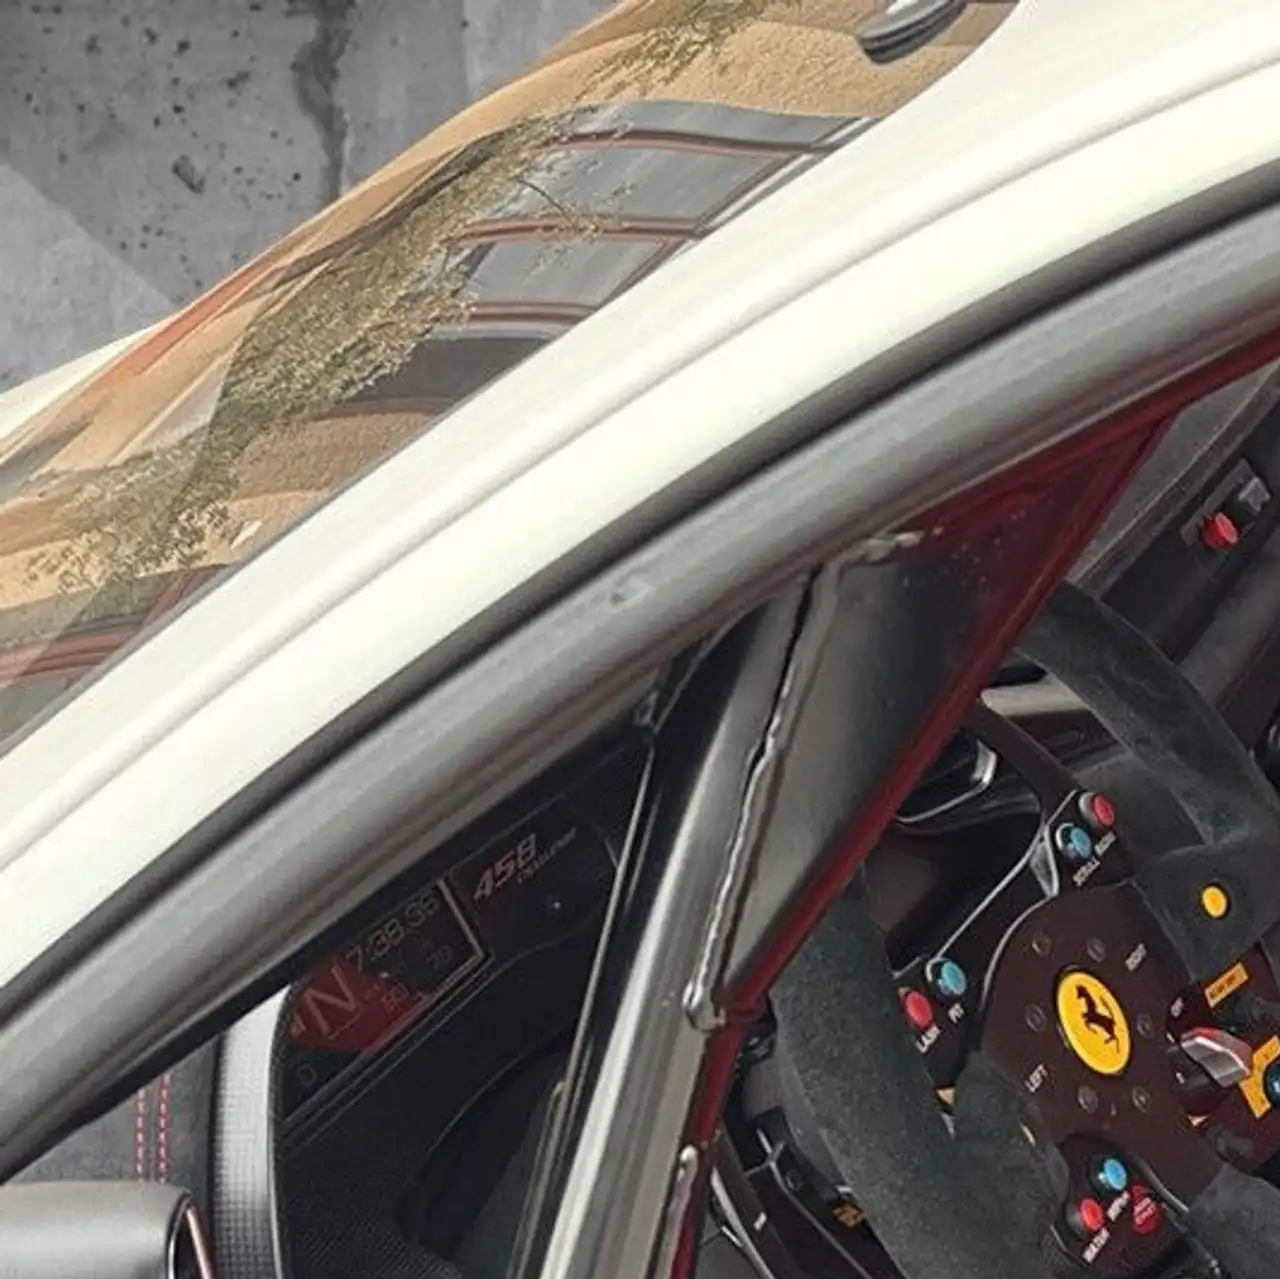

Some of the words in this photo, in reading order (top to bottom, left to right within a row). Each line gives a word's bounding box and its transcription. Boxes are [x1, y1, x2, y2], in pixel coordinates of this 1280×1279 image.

[473, 834, 537, 900] 458
[307, 961, 357, 1036] N
[1025, 1064, 1048, 1093] LEFT
